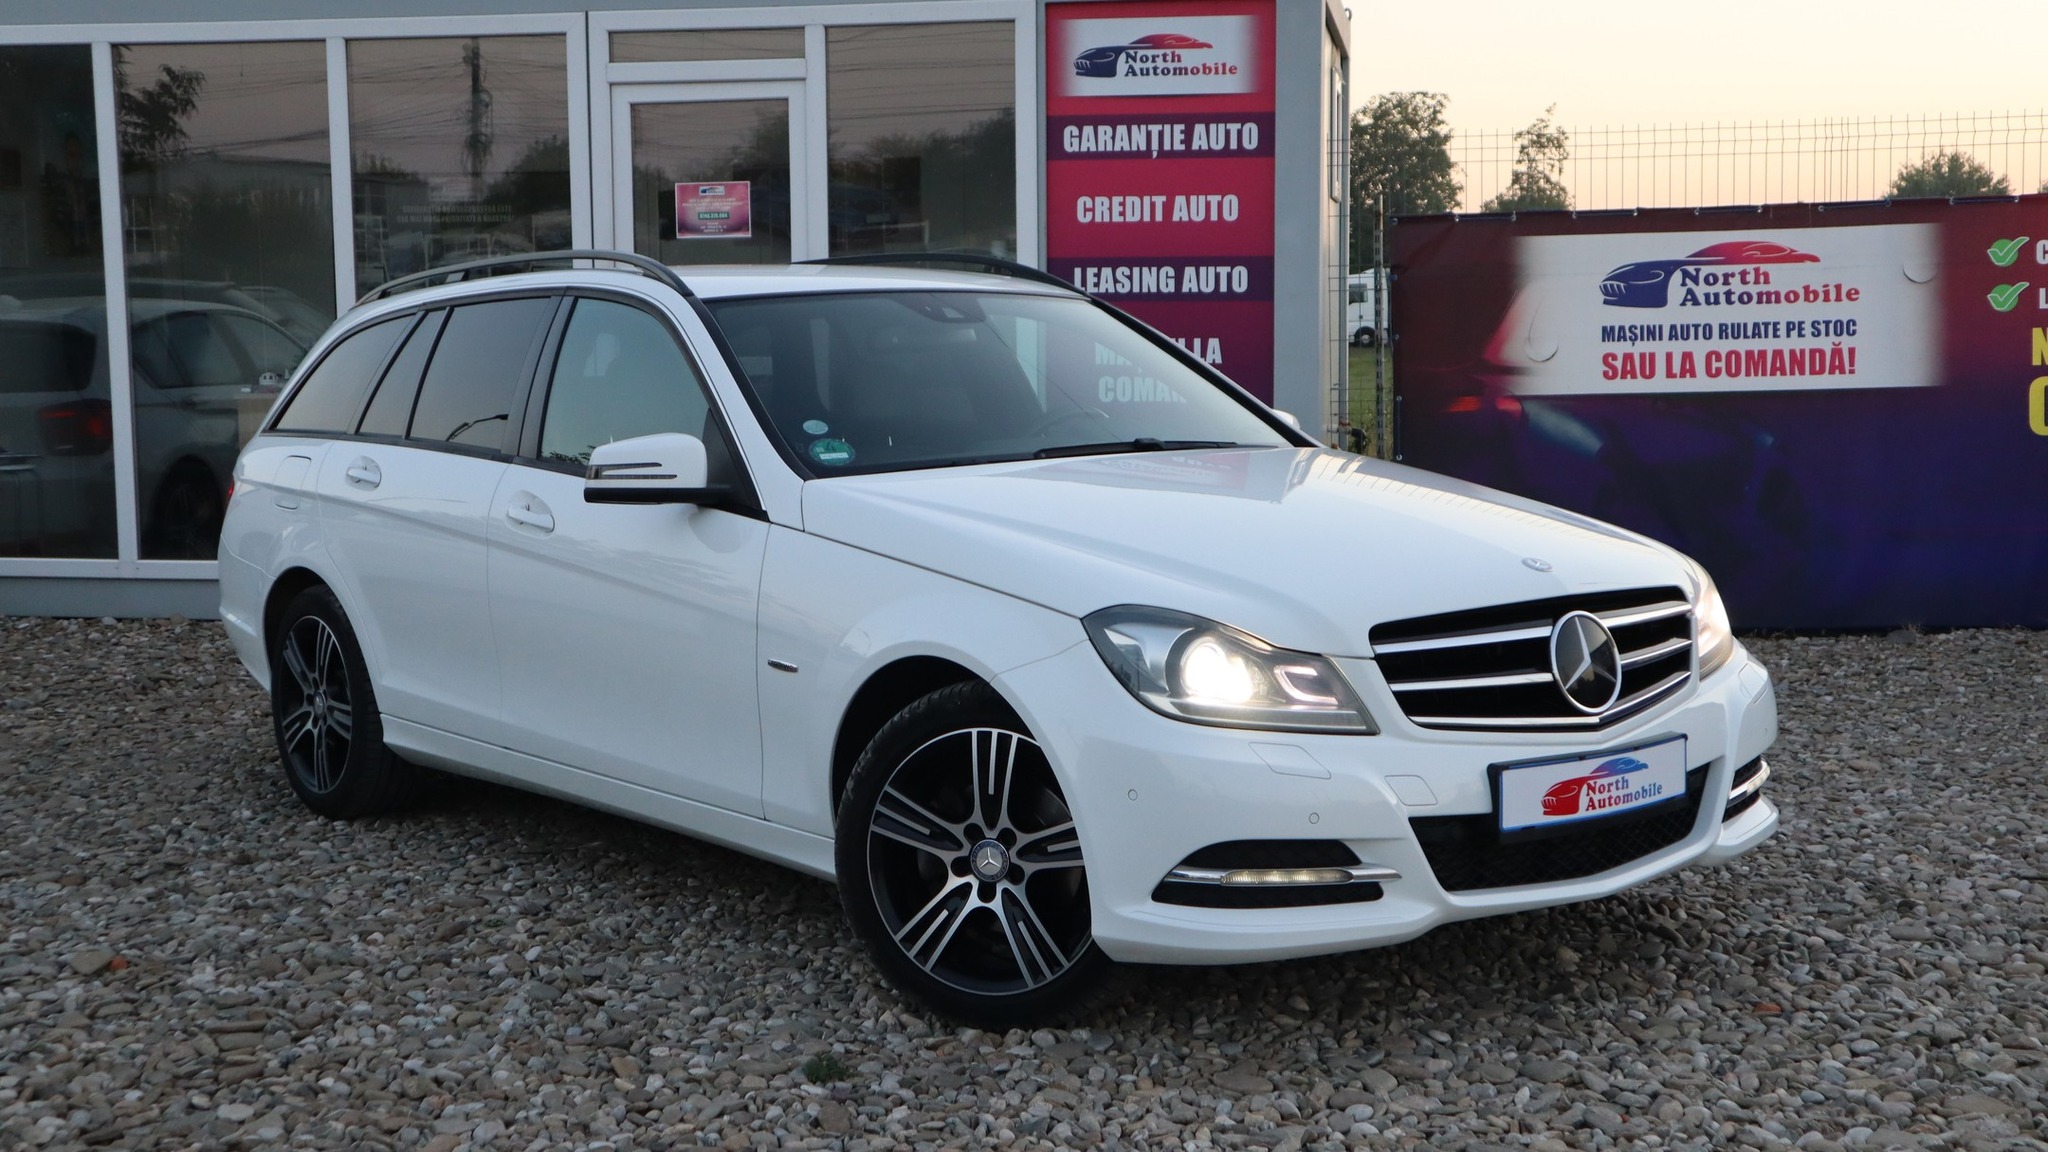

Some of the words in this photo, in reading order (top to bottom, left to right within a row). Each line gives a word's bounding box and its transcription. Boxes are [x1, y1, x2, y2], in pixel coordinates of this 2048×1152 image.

[1124, 50, 1182, 64] North
[1124, 62, 1238, 77] Automobile
[1063, 124, 1186, 159] GARANȚIE
[1192, 122, 1259, 150] AUTO
[1076, 195, 1167, 223] CREDIT
[1172, 194, 1239, 222] AUTO
[1073, 266, 1176, 294] LEASING
[1181, 265, 1249, 293] AUTO
[1679, 266, 1771, 287] North
[1679, 283, 1861, 307] Automobile
[1601, 324, 1664, 347] MAȘINI
[1668, 323, 1713, 341] AUTO
[1718, 321, 1781, 340] RULATE
[1786, 320, 1806, 338] PE
[1810, 318, 1857, 337] STOC
[1602, 351, 1657, 381] SAU
[1665, 351, 1697, 379] LA
[1705, 341, 1857, 378] COMANDĂ!
[1585, 776, 1630, 797] North
[1585, 782, 1663, 812] Automobile
